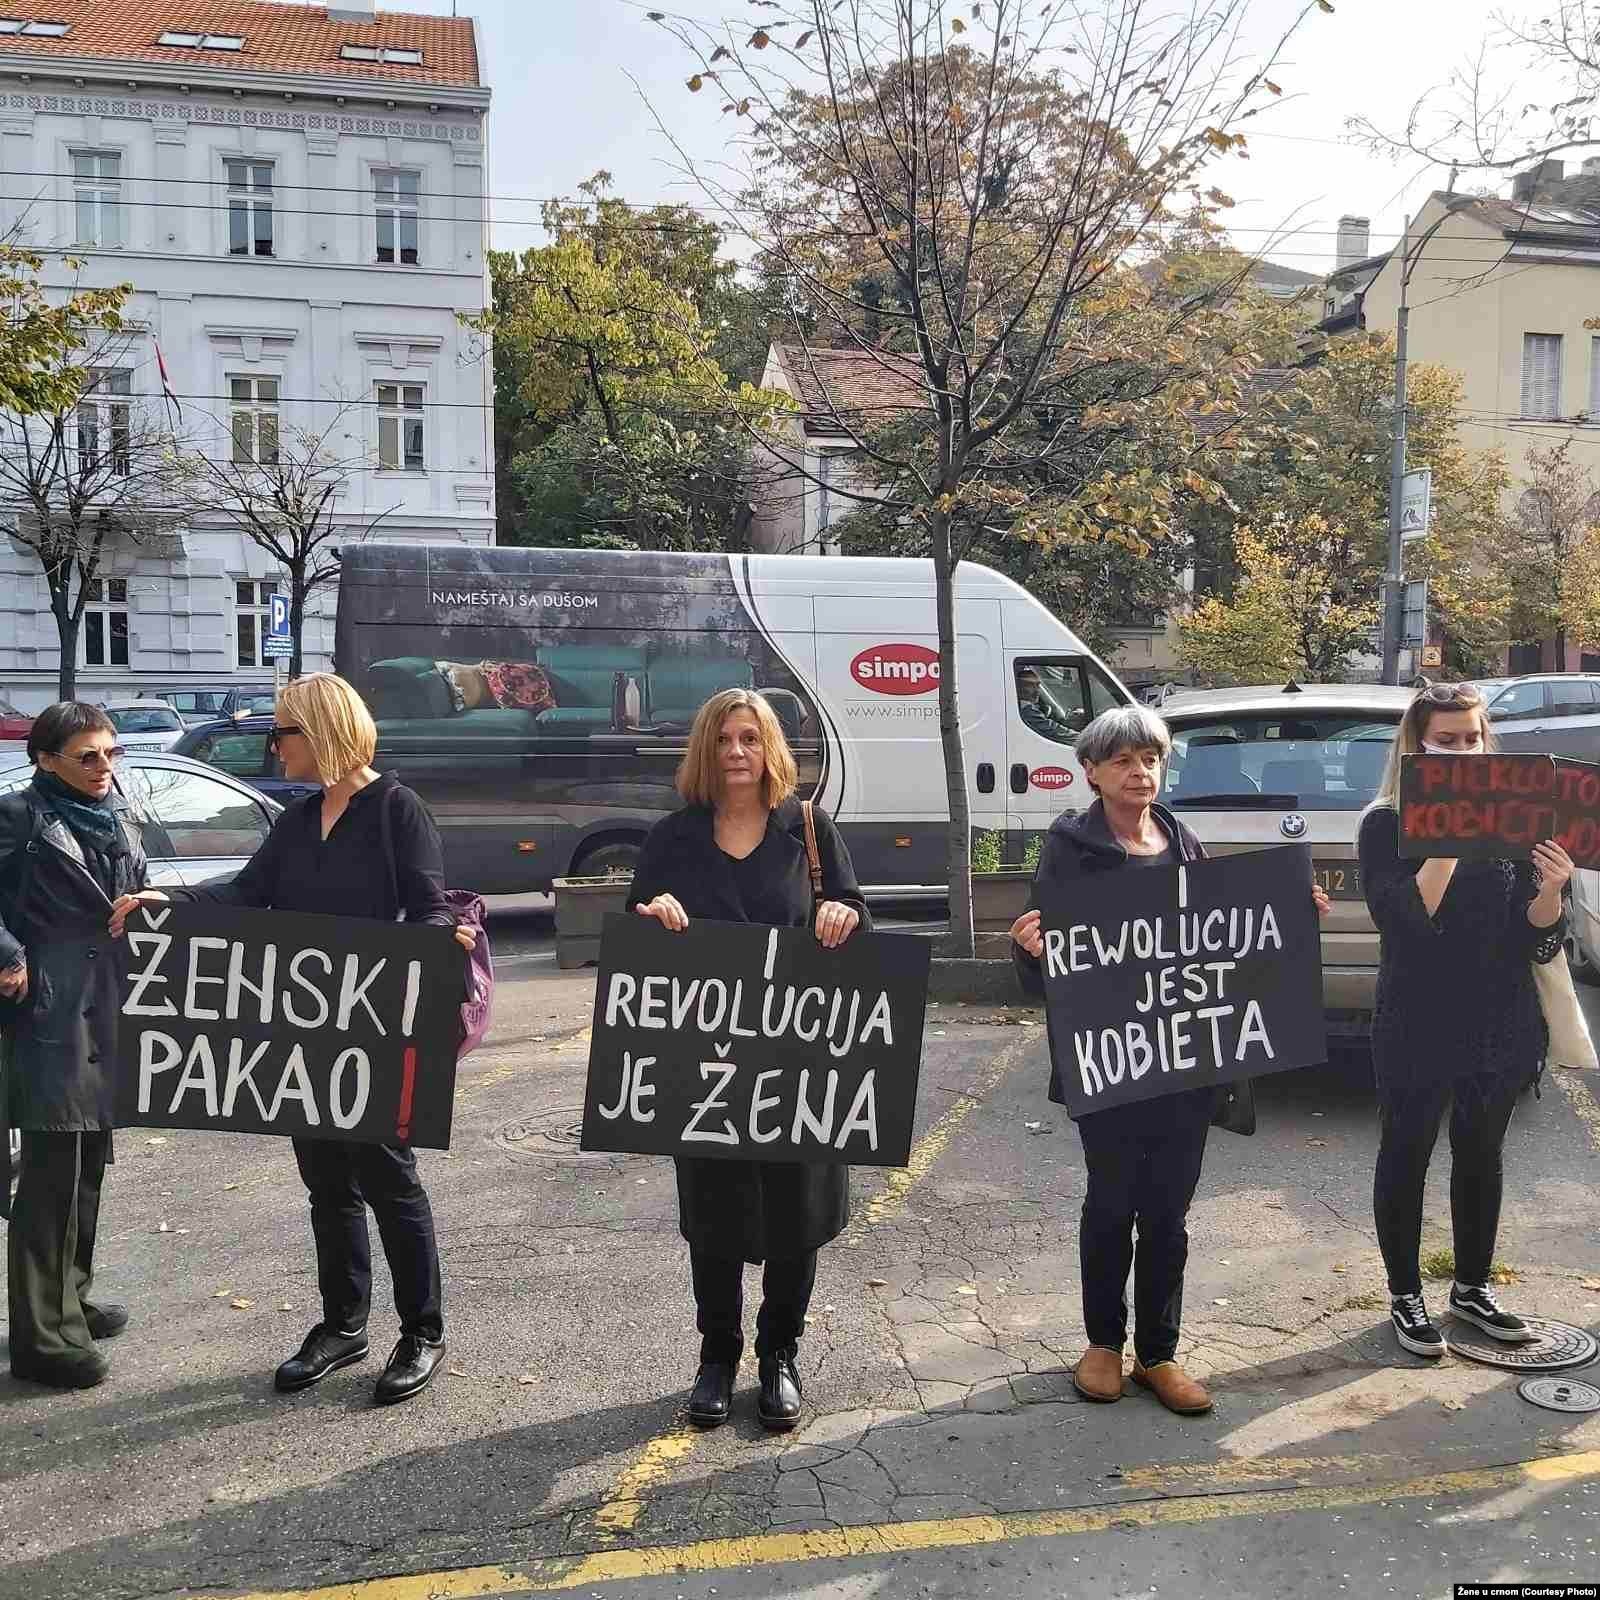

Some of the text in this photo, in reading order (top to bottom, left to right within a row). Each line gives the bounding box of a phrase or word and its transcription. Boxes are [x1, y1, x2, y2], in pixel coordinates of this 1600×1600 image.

[274, 599, 285, 631] P
[432, 590, 598, 608] NAMEŠTAJ SA DUŠOM
[1032, 771, 1071, 784] simpo
[121, 907, 421, 1036] ŽENSKI
[1044, 904, 1282, 978] REWOLUCIJA
[605, 973, 893, 1056] REVOLUCIJA
[1136, 962, 1236, 1013] JEST
[1074, 1000, 1275, 1096] KOBIETA
[598, 1041, 879, 1151] JE ŽENA
